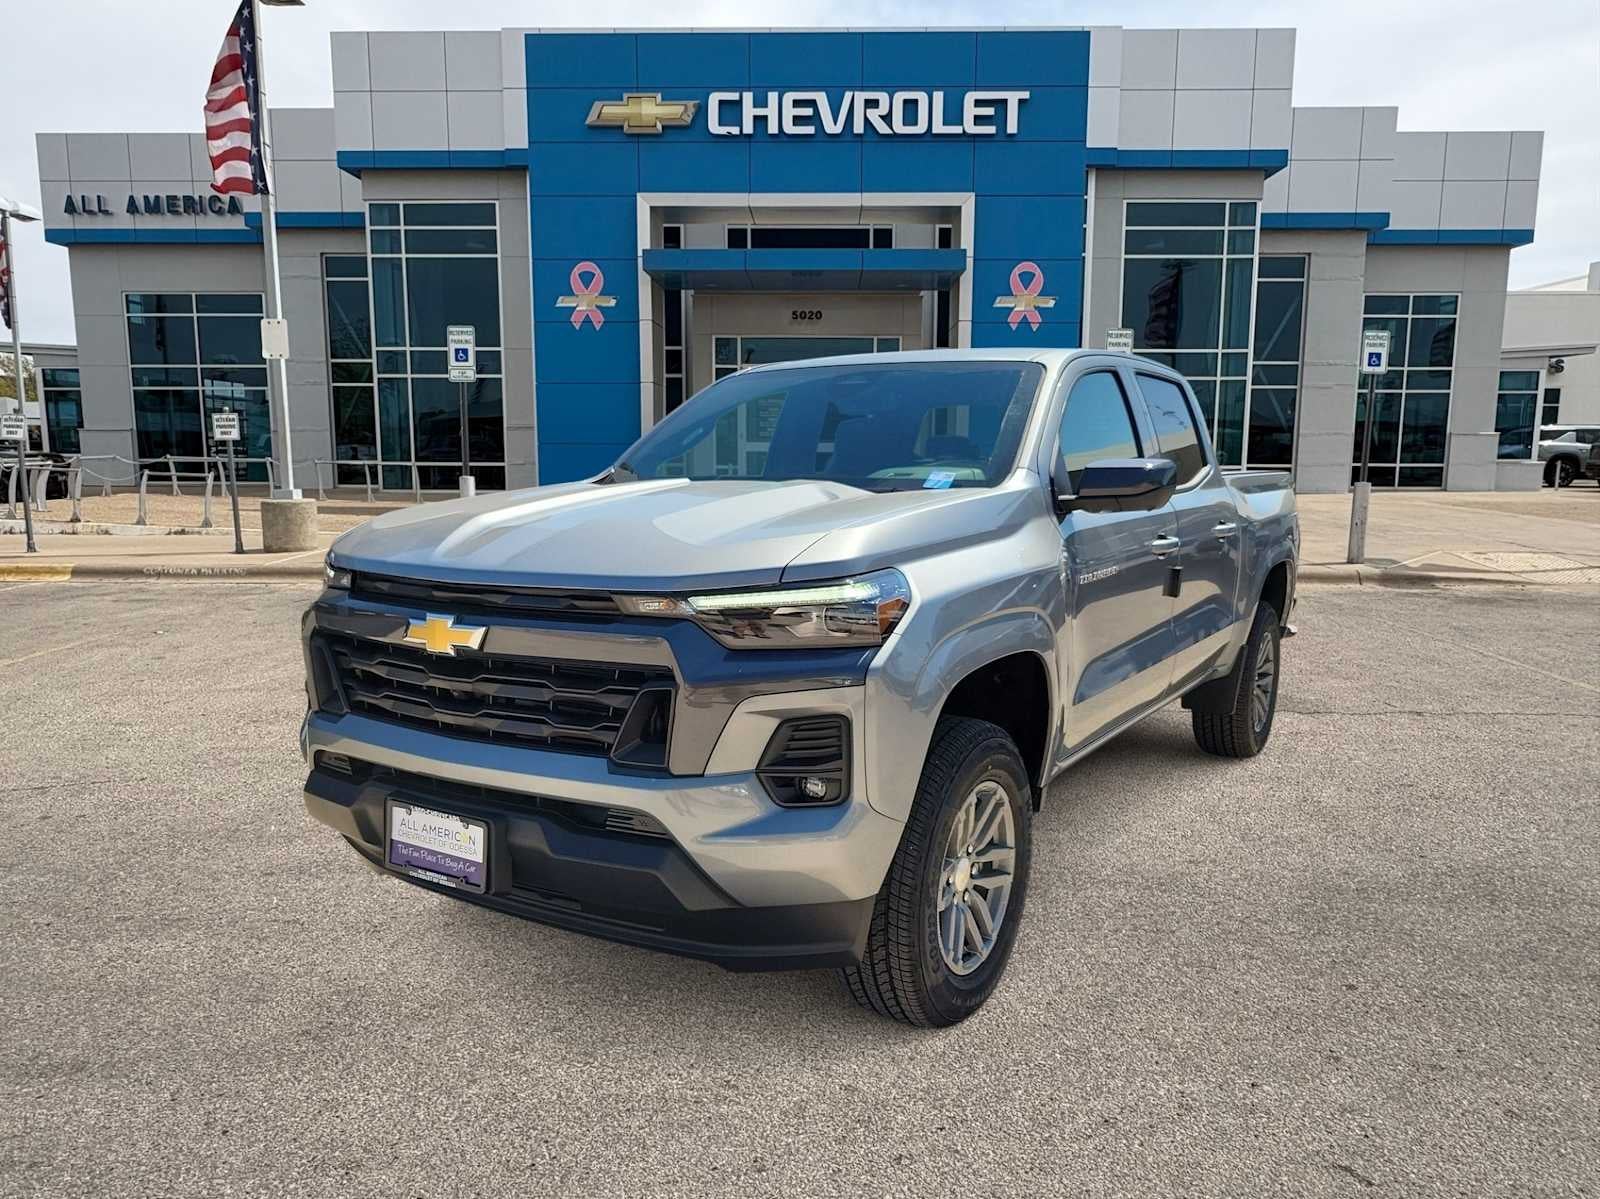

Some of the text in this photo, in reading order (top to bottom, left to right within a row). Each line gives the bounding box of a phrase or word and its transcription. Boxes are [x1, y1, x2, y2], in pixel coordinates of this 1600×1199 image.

[707, 90, 1031, 136] CHEVROLET
[63, 194, 244, 216] ALL AMERICA
[791, 310, 823, 320] 5020
[400, 817, 477, 847] ALL AMERICN
[438, 839, 447, 848] OF
[449, 842, 478, 857] ODESSA
[421, 849, 437, 864] Place
[437, 854, 445, 864] To
[445, 857, 458, 872] Buy
[458, 861, 465, 872] A
[465, 862, 477, 873] Car
